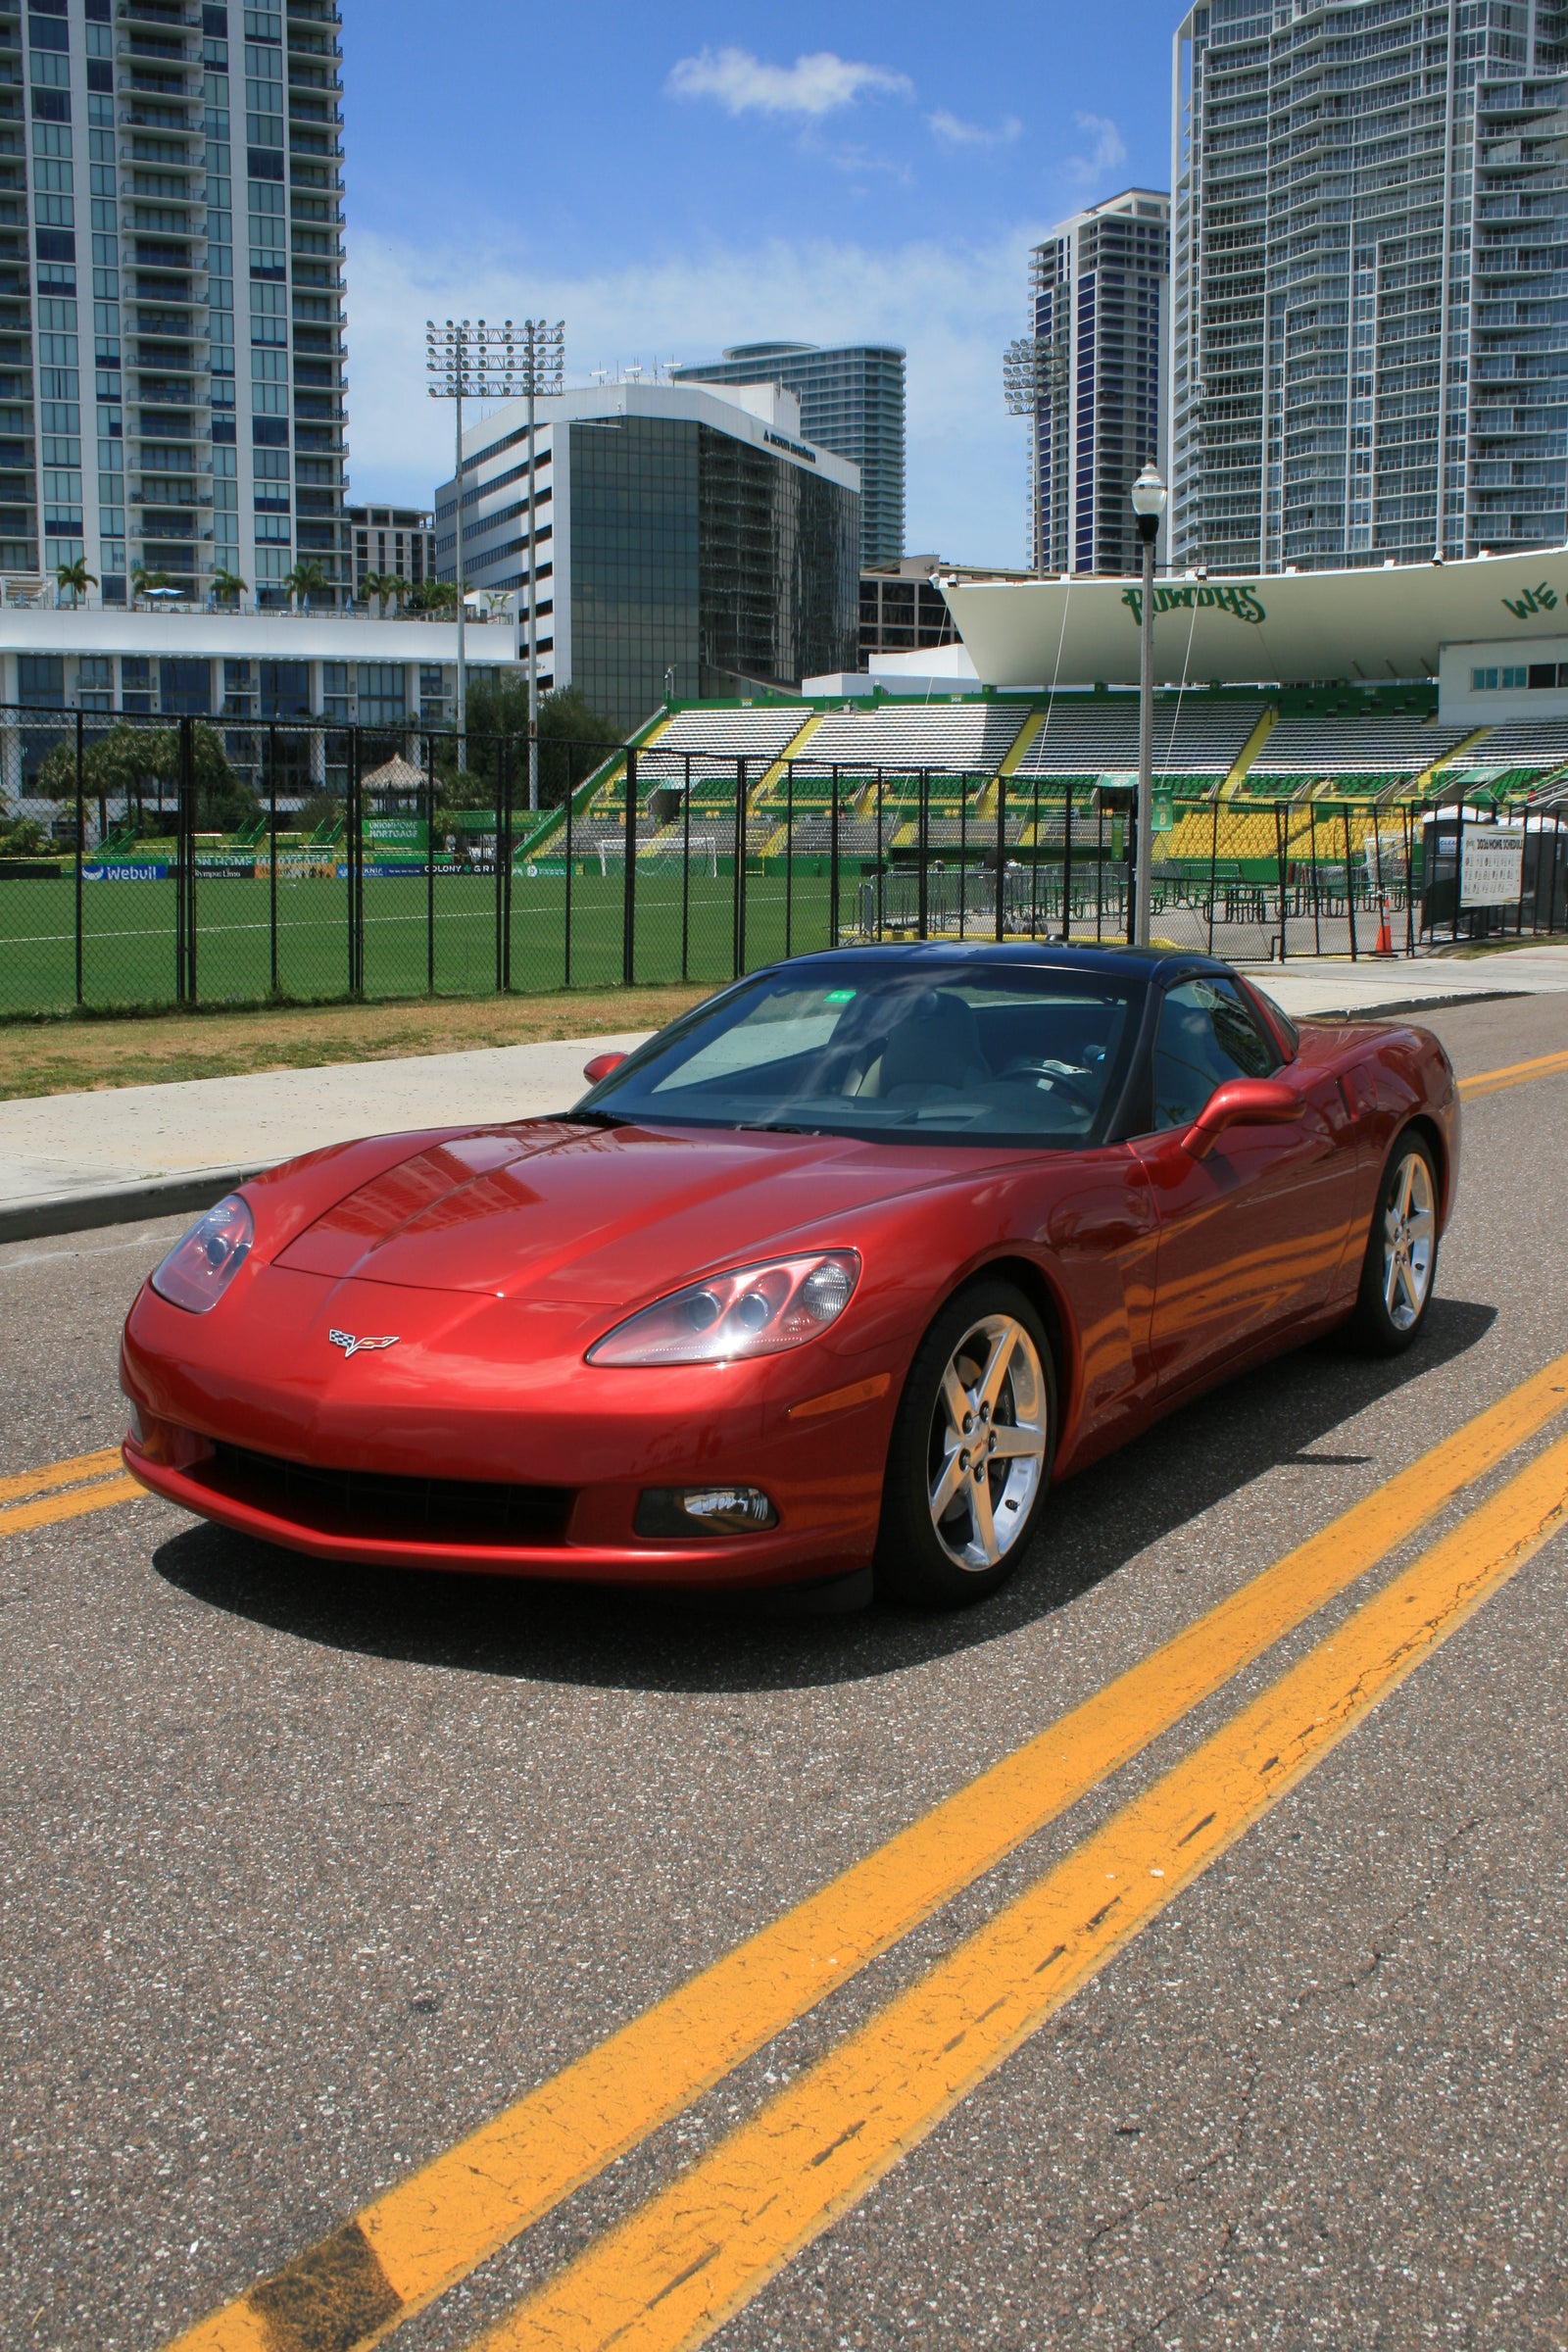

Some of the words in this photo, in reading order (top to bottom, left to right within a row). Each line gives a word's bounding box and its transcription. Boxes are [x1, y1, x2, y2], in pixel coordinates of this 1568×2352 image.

[1120, 586, 1266, 626] ROWDIES
[1500, 581, 1558, 619] WE
[1159, 812, 1167, 826] 8
[1489, 839, 1502, 850] HOME
[107, 866, 157, 880] Webull
